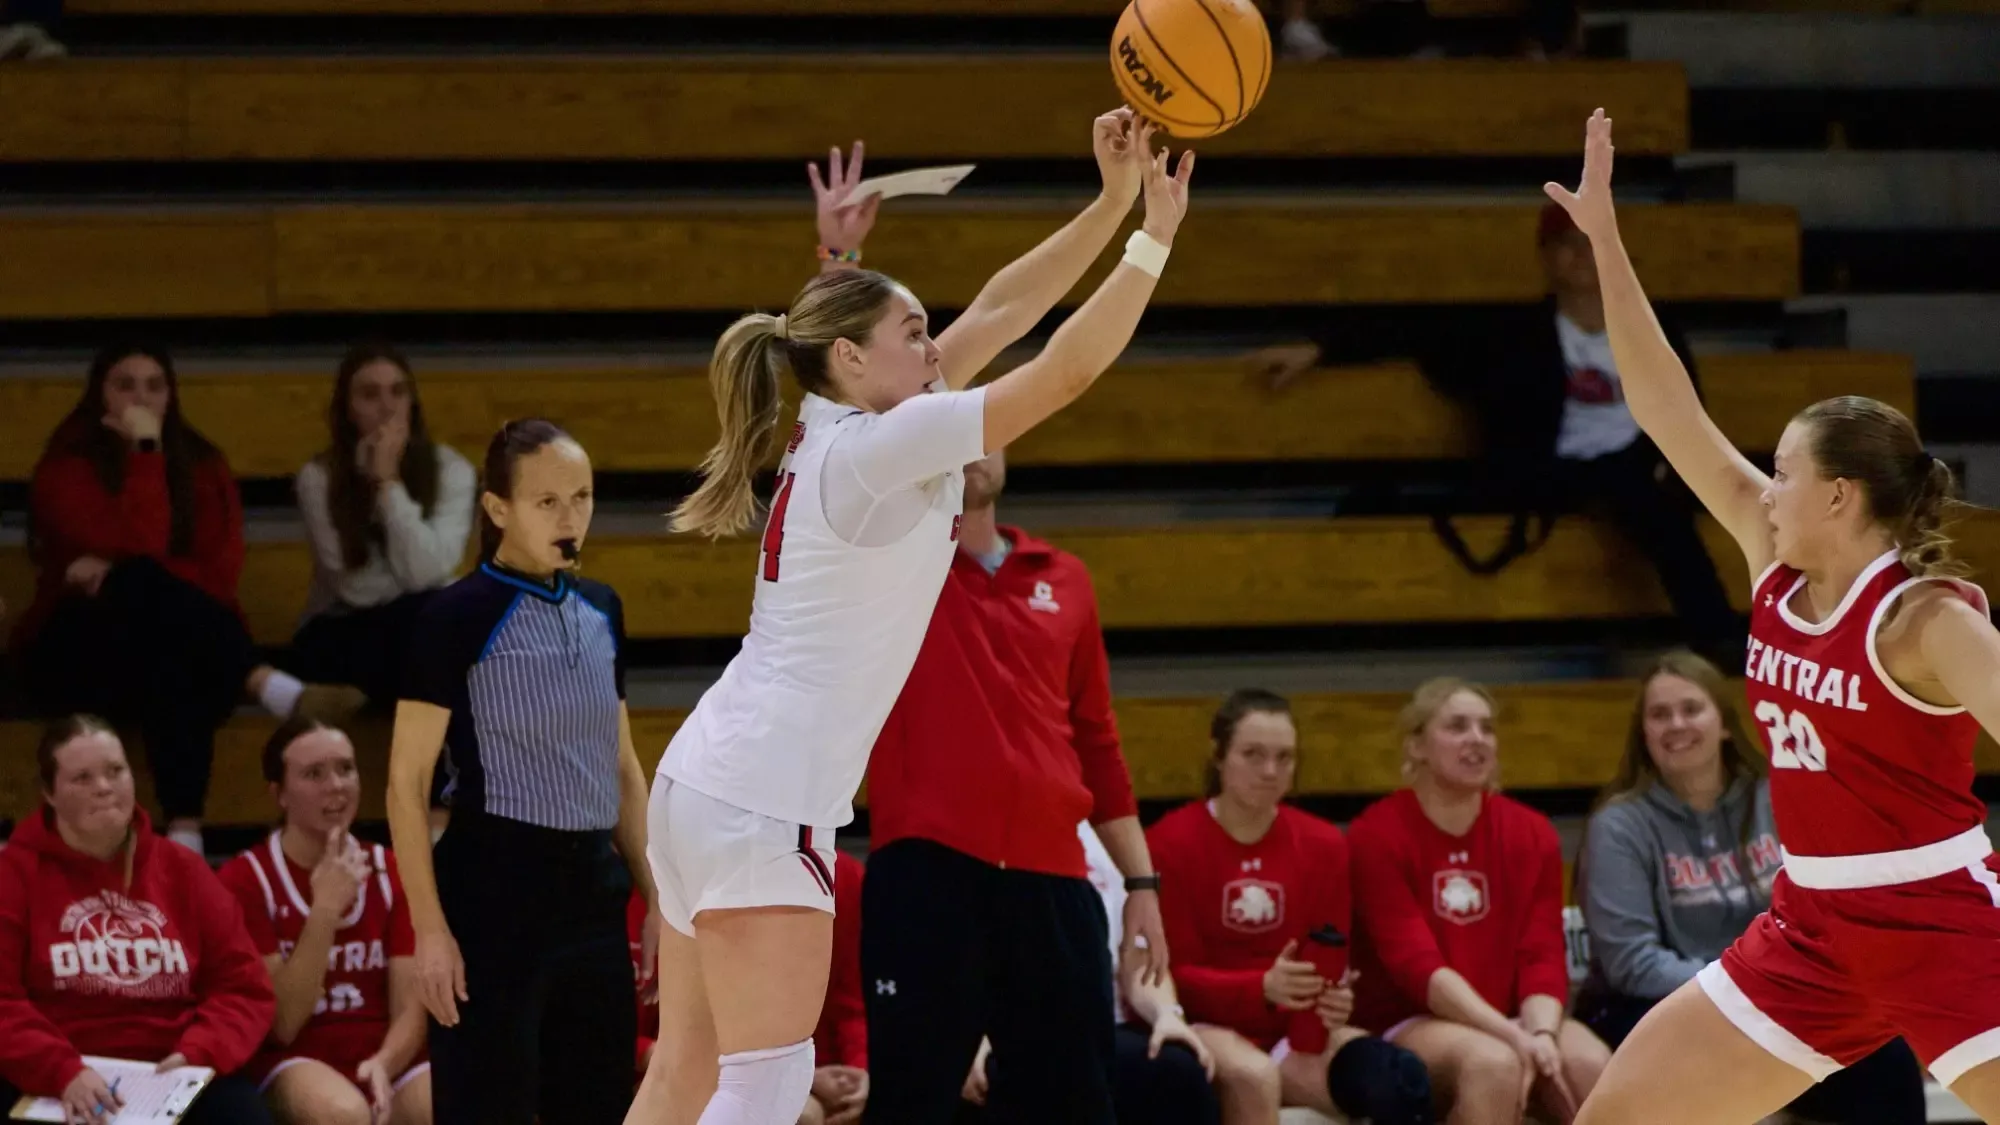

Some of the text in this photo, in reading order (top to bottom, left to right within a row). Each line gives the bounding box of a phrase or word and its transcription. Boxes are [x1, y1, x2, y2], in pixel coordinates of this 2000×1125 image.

[1118, 35, 1174, 106] NCAA
[1745, 634, 1869, 712] ENTRAL
[1754, 699, 1828, 772] 20
[49, 937, 190, 978] DUTCH
